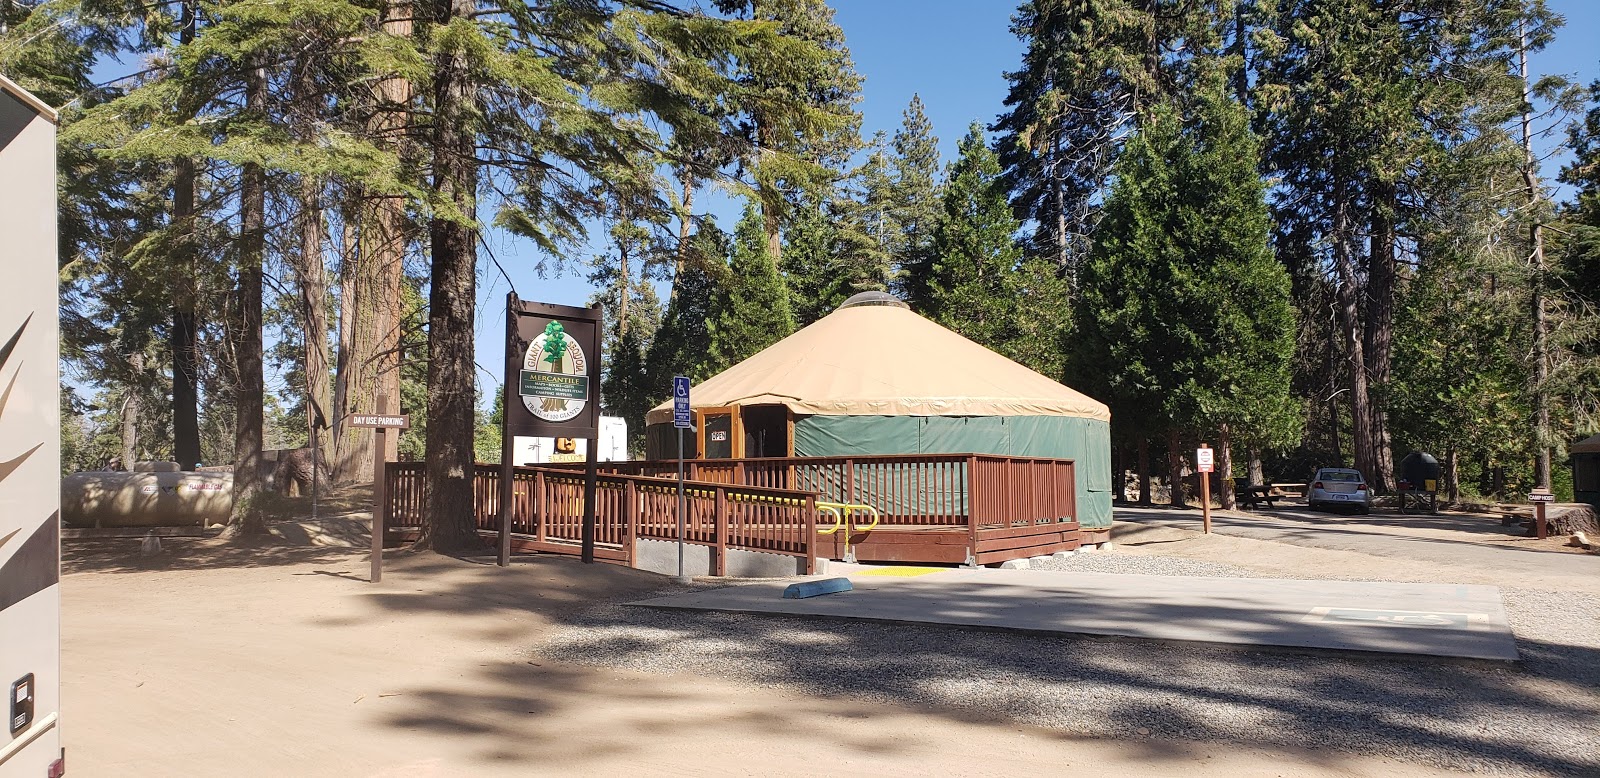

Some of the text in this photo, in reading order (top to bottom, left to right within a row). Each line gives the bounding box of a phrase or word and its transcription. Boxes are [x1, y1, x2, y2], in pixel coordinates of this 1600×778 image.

[528, 341, 542, 367] GIANT
[568, 341, 584, 372] SEQUOIA
[530, 374, 580, 384] MERCANTILE
[527, 401, 542, 416] TRAIL
[560, 406, 580, 418] GIANTS
[354, 416, 404, 426] DAY USE PARKING
[712, 432, 726, 440] OPEN
[552, 454, 584, 462] WELCOME
